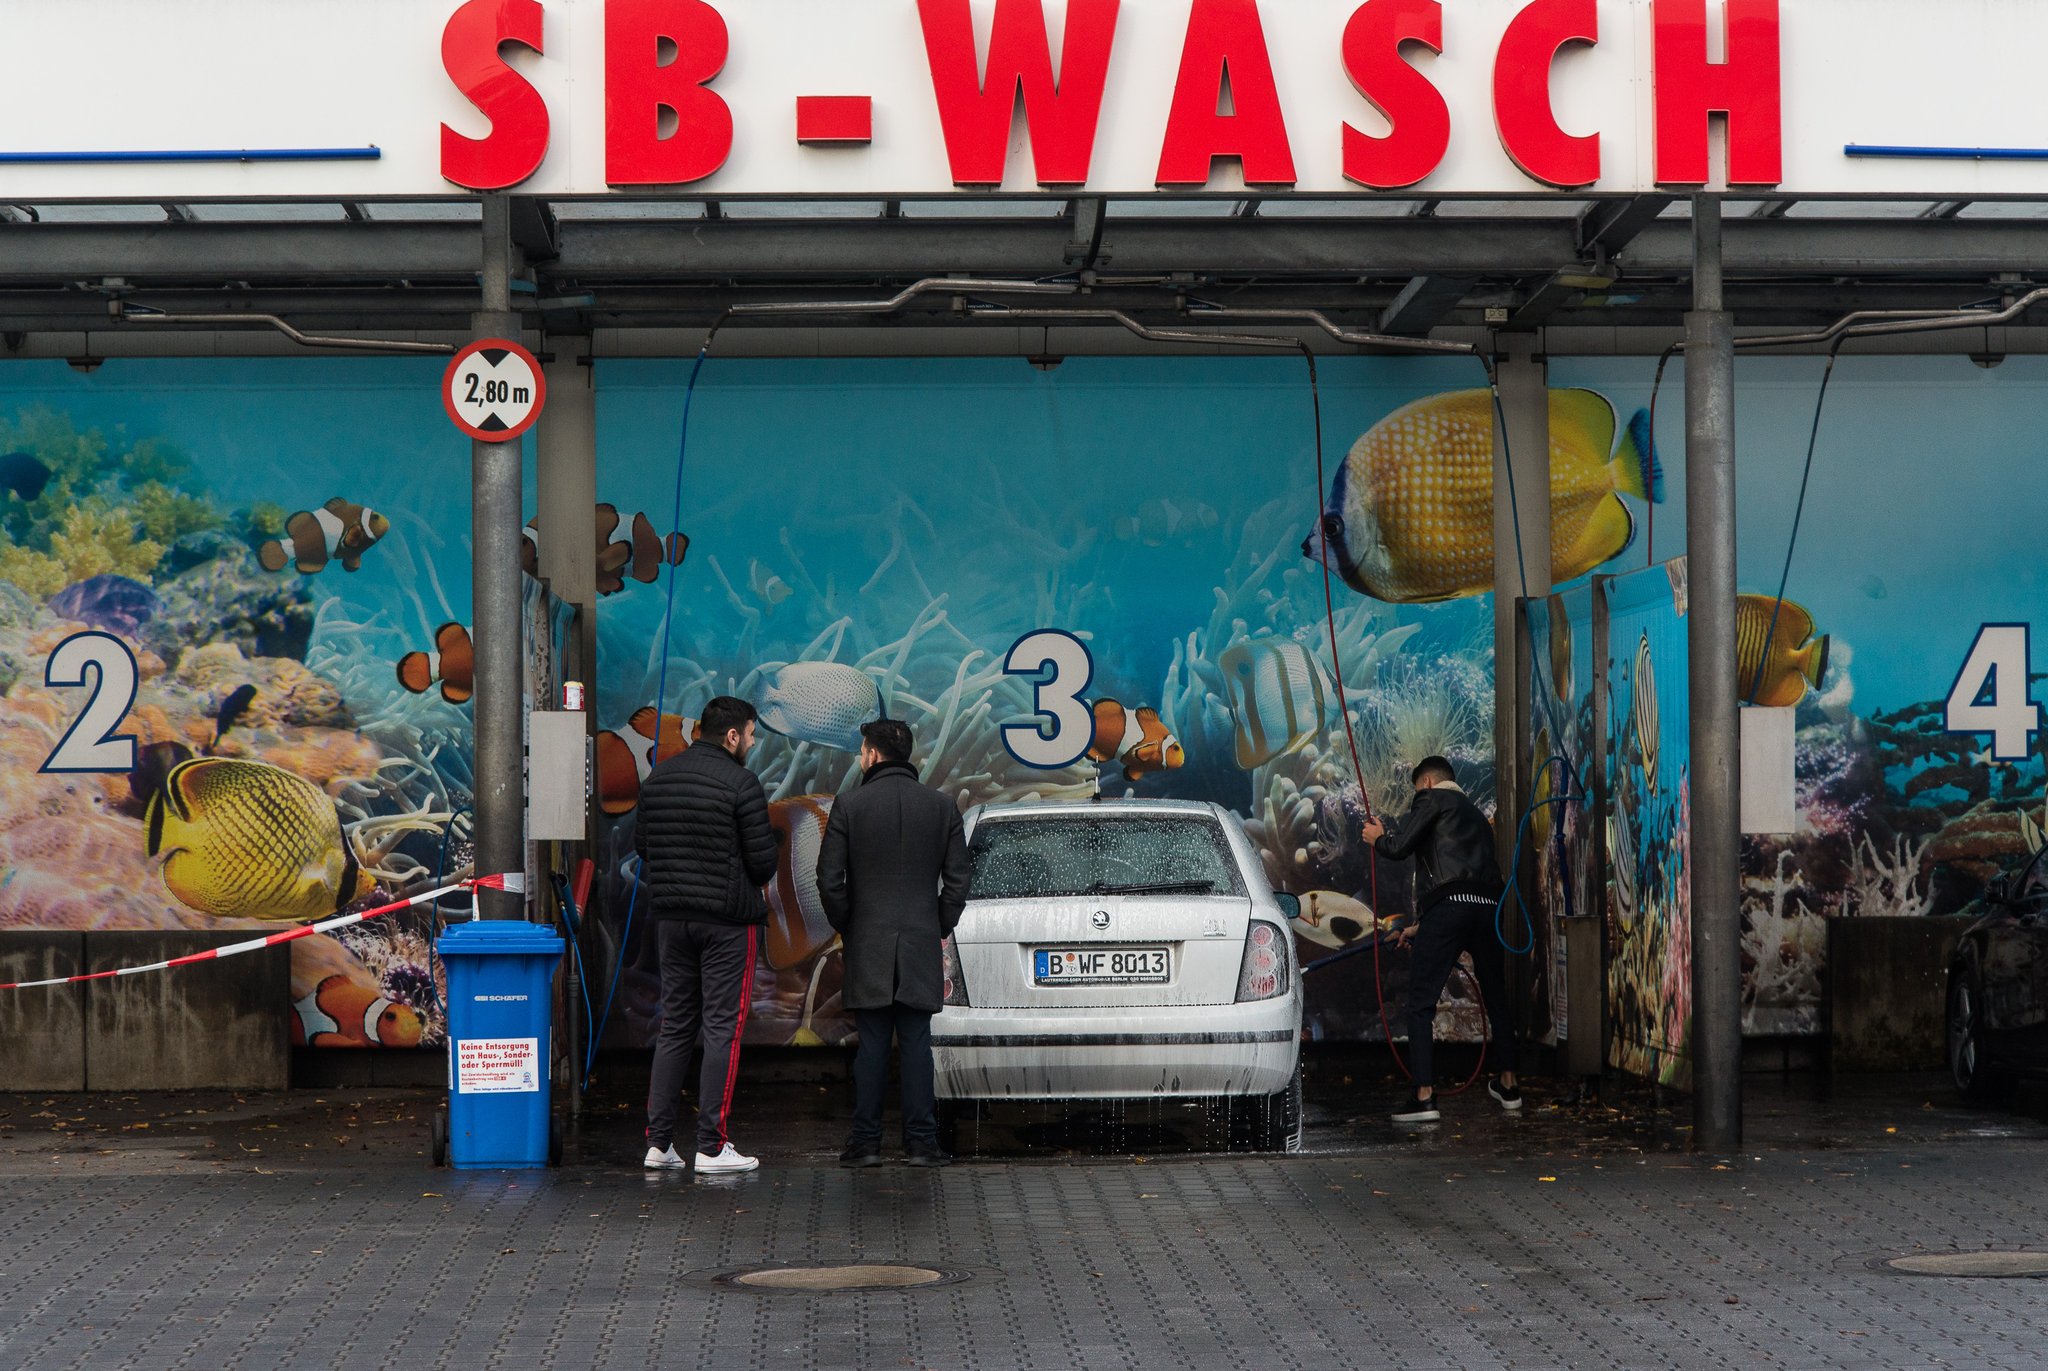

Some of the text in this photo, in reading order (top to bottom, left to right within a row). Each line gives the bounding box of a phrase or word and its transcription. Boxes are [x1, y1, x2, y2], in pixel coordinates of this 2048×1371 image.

[464, 372, 529, 408] 2,80 m
[37, 630, 139, 774] 2
[1000, 628, 1097, 770] 3
[1943, 622, 2043, 761] 4
[1050, 953, 1164, 975] B WF 8013
[481, 1060, 523, 1070] Sperrmüll!
[485, 1043, 529, 1051] Entsorgung
